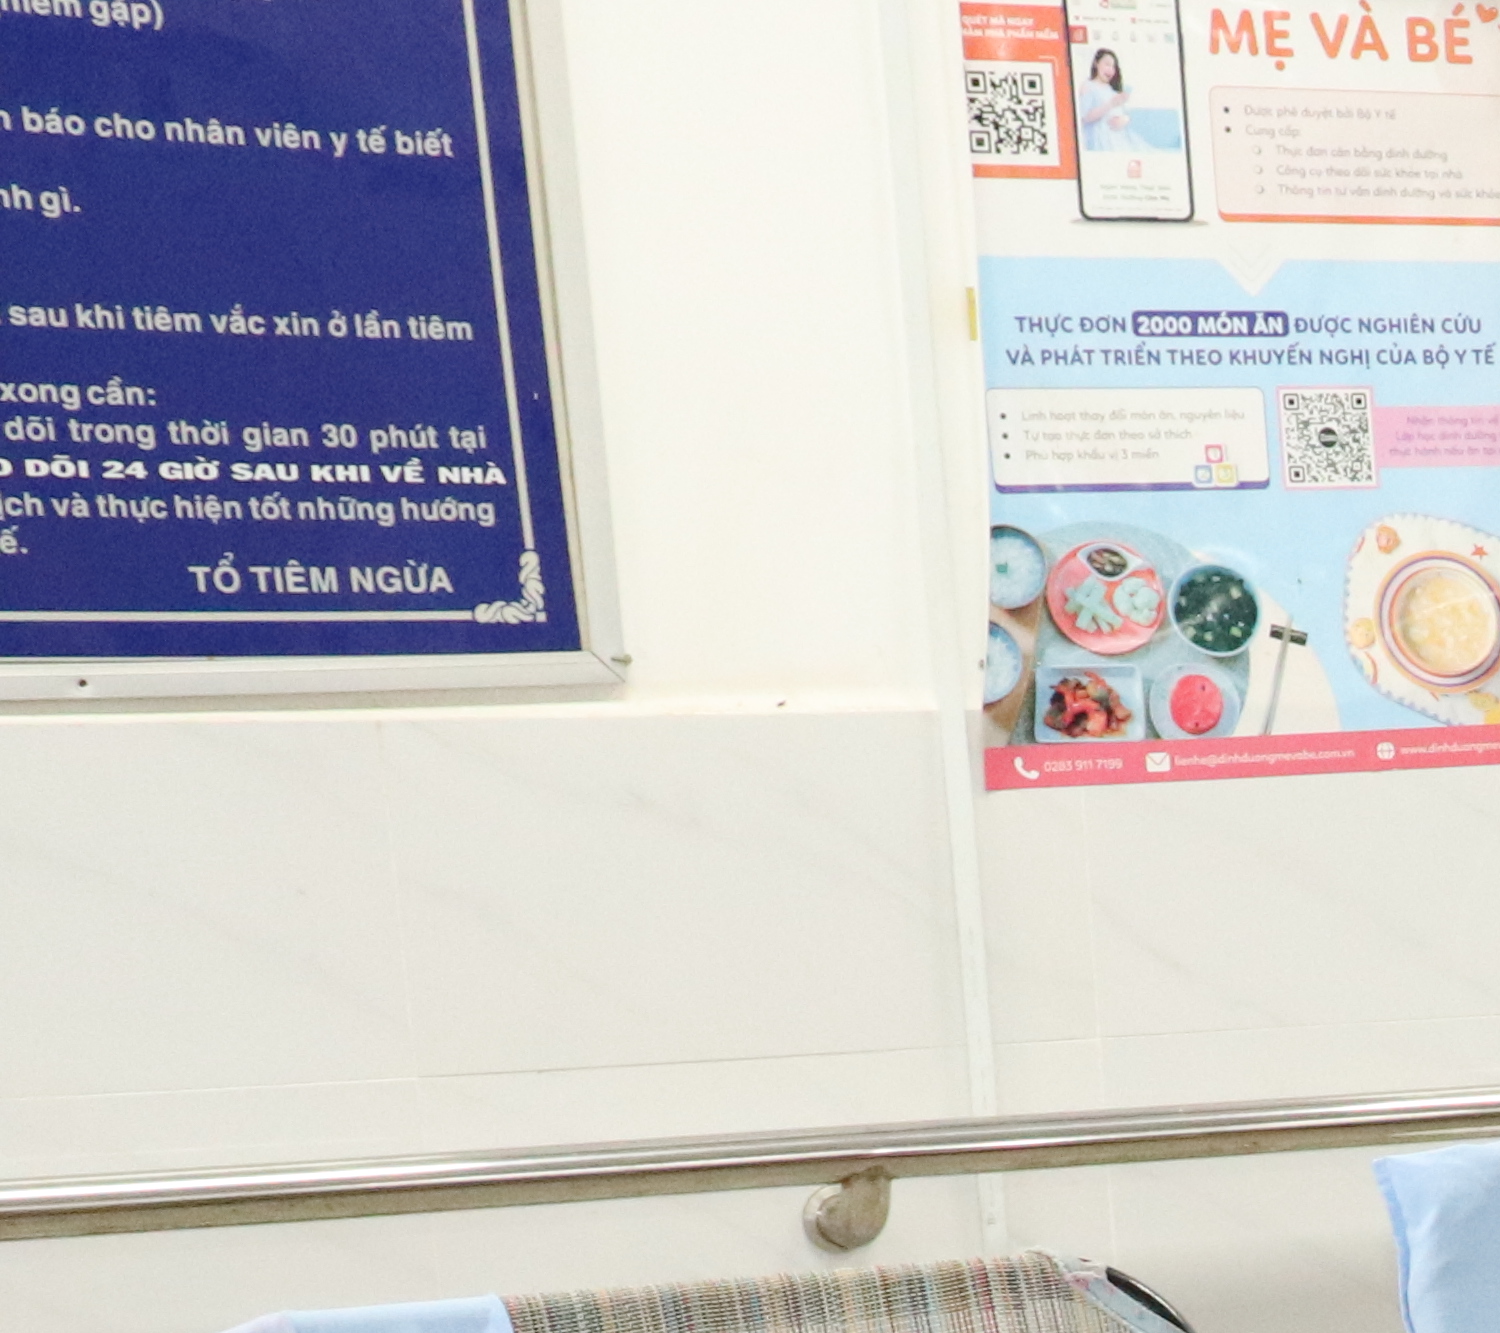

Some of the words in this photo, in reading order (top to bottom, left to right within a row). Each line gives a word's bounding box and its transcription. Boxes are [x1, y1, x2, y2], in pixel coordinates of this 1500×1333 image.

[1210, 8, 1294, 71] MẸ
[1309, 0, 1389, 61] VÀ
[1406, 3, 1474, 64] BÉ
[21, 105, 87, 136] báo
[94, 112, 156, 141] cho
[164, 117, 246, 146] nhân
[254, 121, 321, 150] viên
[329, 131, 348, 158] y
[356, 125, 387, 154] tế
[394, 127, 455, 158] biết
[40, 185, 82, 218] gì.
[8, 304, 69, 329] sau
[75, 303, 126, 330] khi
[132, 306, 203, 334] tiêm
[209, 303, 266, 336] vắc
[272, 311, 320, 337] xin
[327, 309, 349, 338] ở
[353, 309, 400, 339] lần
[406, 315, 474, 341] tiêm
[1014, 313, 1074, 337] THỰC
[1079, 314, 1127, 334] ĐƠN
[1137, 316, 1192, 335] 2000
[1197, 311, 1249, 335] MÓN
[1253, 312, 1284, 334] ĂN
[1294, 314, 1352, 337] ĐƯỢC
[1358, 313, 1435, 334] NGHIÊN
[1441, 312, 1481, 334] CỨU
[1005, 344, 1036, 366] VÀ
[1041, 344, 1096, 366] PHÁT
[1100, 341, 1161, 366] TRIỂN
[1166, 349, 1223, 366] THEO
[1229, 342, 1313, 366] KHUYẾN
[1319, 349, 1371, 369] NGHỊ
[1376, 342, 1418, 366] CỦA
[1422, 344, 1450, 369] BỘ
[1454, 349, 1468, 366] Y
[1472, 342, 1497, 365] TẾ
[0, 382, 81, 411] xong
[86, 376, 157, 407] cần:
[4, 416, 56, 442] dõi
[67, 418, 156, 451] trong
[167, 419, 230, 446] thời
[242, 421, 309, 452] gian
[321, 423, 358, 449] 30
[369, 424, 440, 454] phút
[448, 425, 487, 454] tại
[24, 454, 91, 479] DÕI
[101, 461, 149, 480] 24
[158, 455, 220, 481] GIỜ
[230, 462, 300, 481] SAU
[310, 464, 371, 483] KHI
[379, 457, 426, 483] VỀ
[437, 461, 507, 484] NHÀ
[1121, 449, 1129, 460] 3
[51, 491, 91, 518] và
[95, 493, 168, 523] thực
[172, 493, 243, 524] hiện
[248, 491, 292, 520] tốt
[297, 496, 395, 527] những
[400, 496, 496, 527] hướng
[187, 552, 241, 594] TỔ
[247, 559, 339, 594] TIÊM
[349, 559, 455, 595] NGỪA
